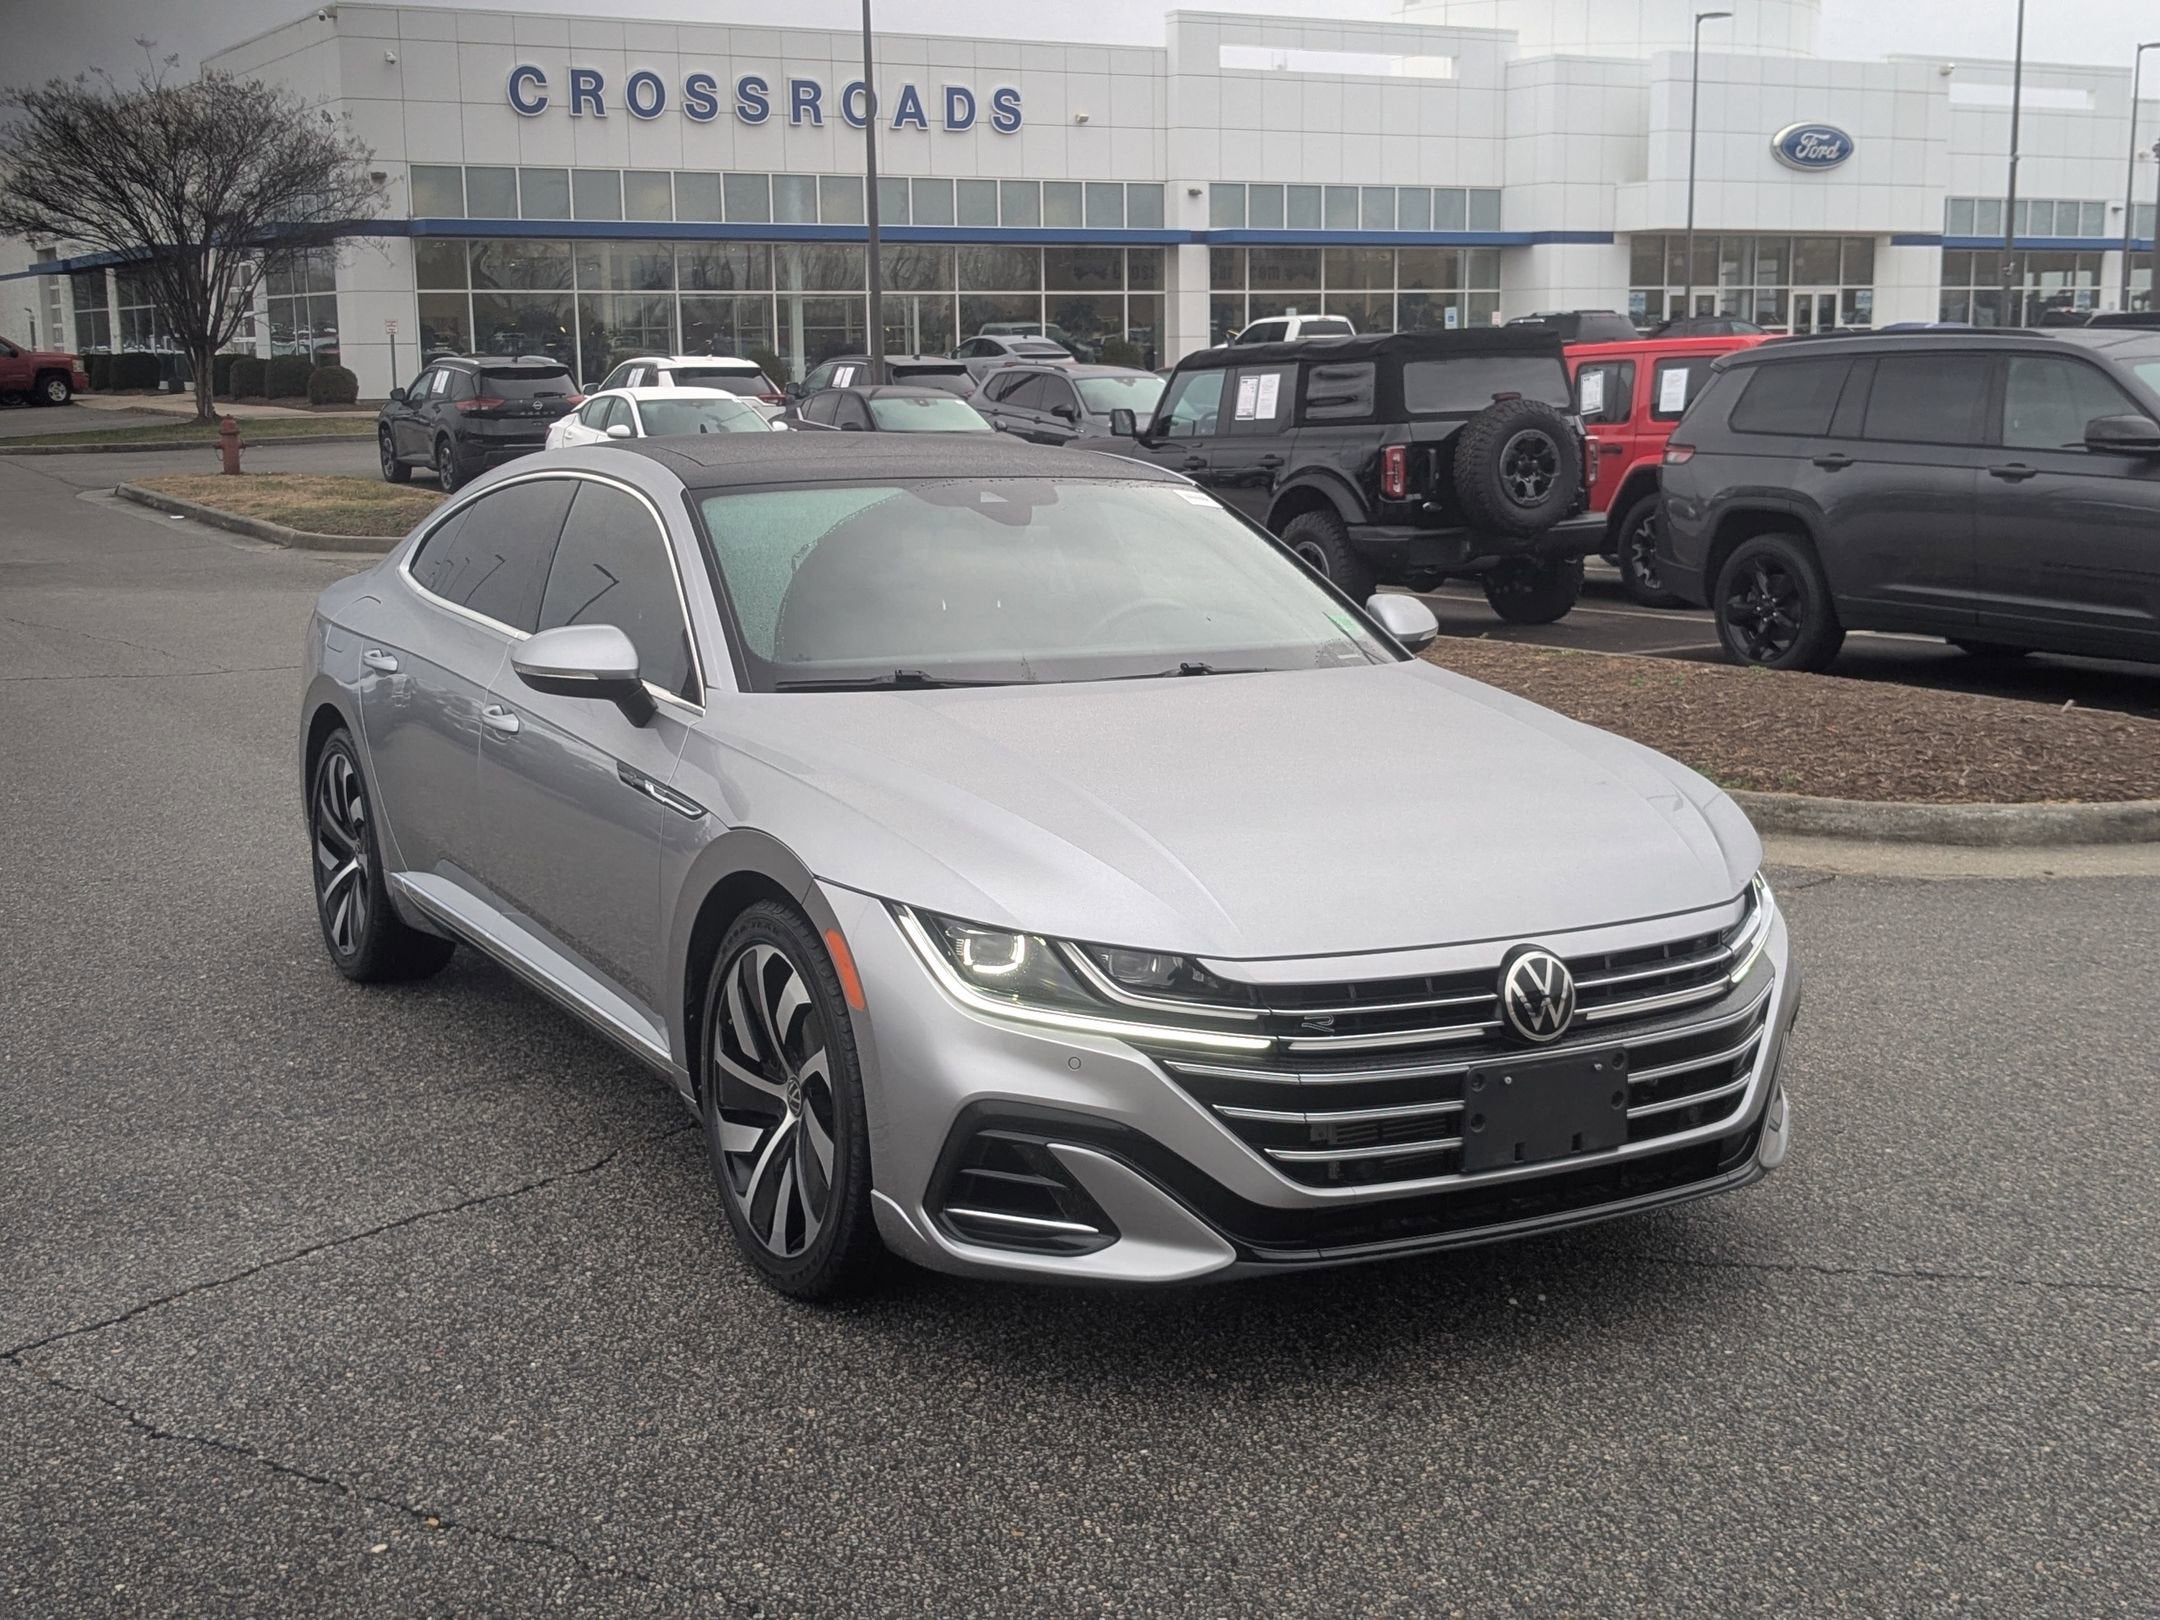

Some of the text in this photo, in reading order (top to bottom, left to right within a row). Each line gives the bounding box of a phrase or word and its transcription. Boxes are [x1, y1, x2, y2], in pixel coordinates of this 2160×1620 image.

[507, 63, 1023, 134] CROSSROADS
[1795, 132, 1842, 159] Ford
[1505, 952, 1575, 1040] VW
